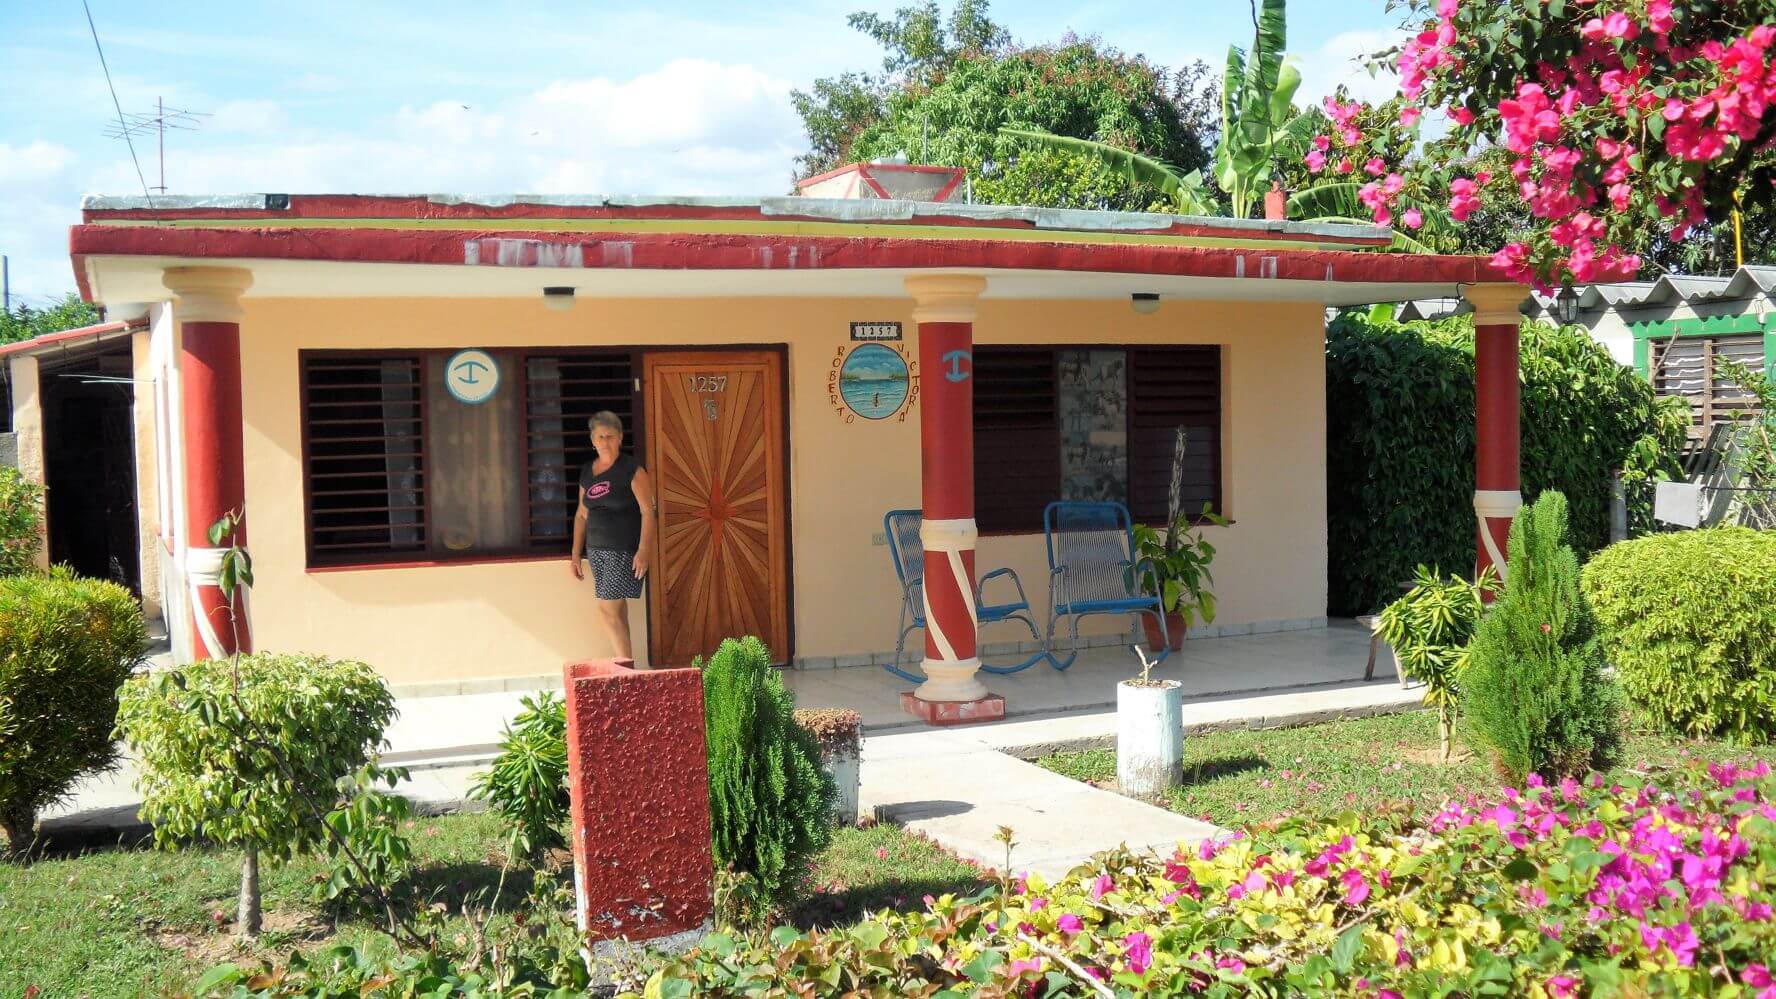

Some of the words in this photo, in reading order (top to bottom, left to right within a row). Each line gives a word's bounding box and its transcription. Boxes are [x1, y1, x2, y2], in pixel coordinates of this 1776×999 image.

[861, 326, 892, 336] 1257
[689, 375, 727, 393] 1257
[828, 345, 855, 424] ROBERTO
[897, 343, 921, 423] VICTORIA
